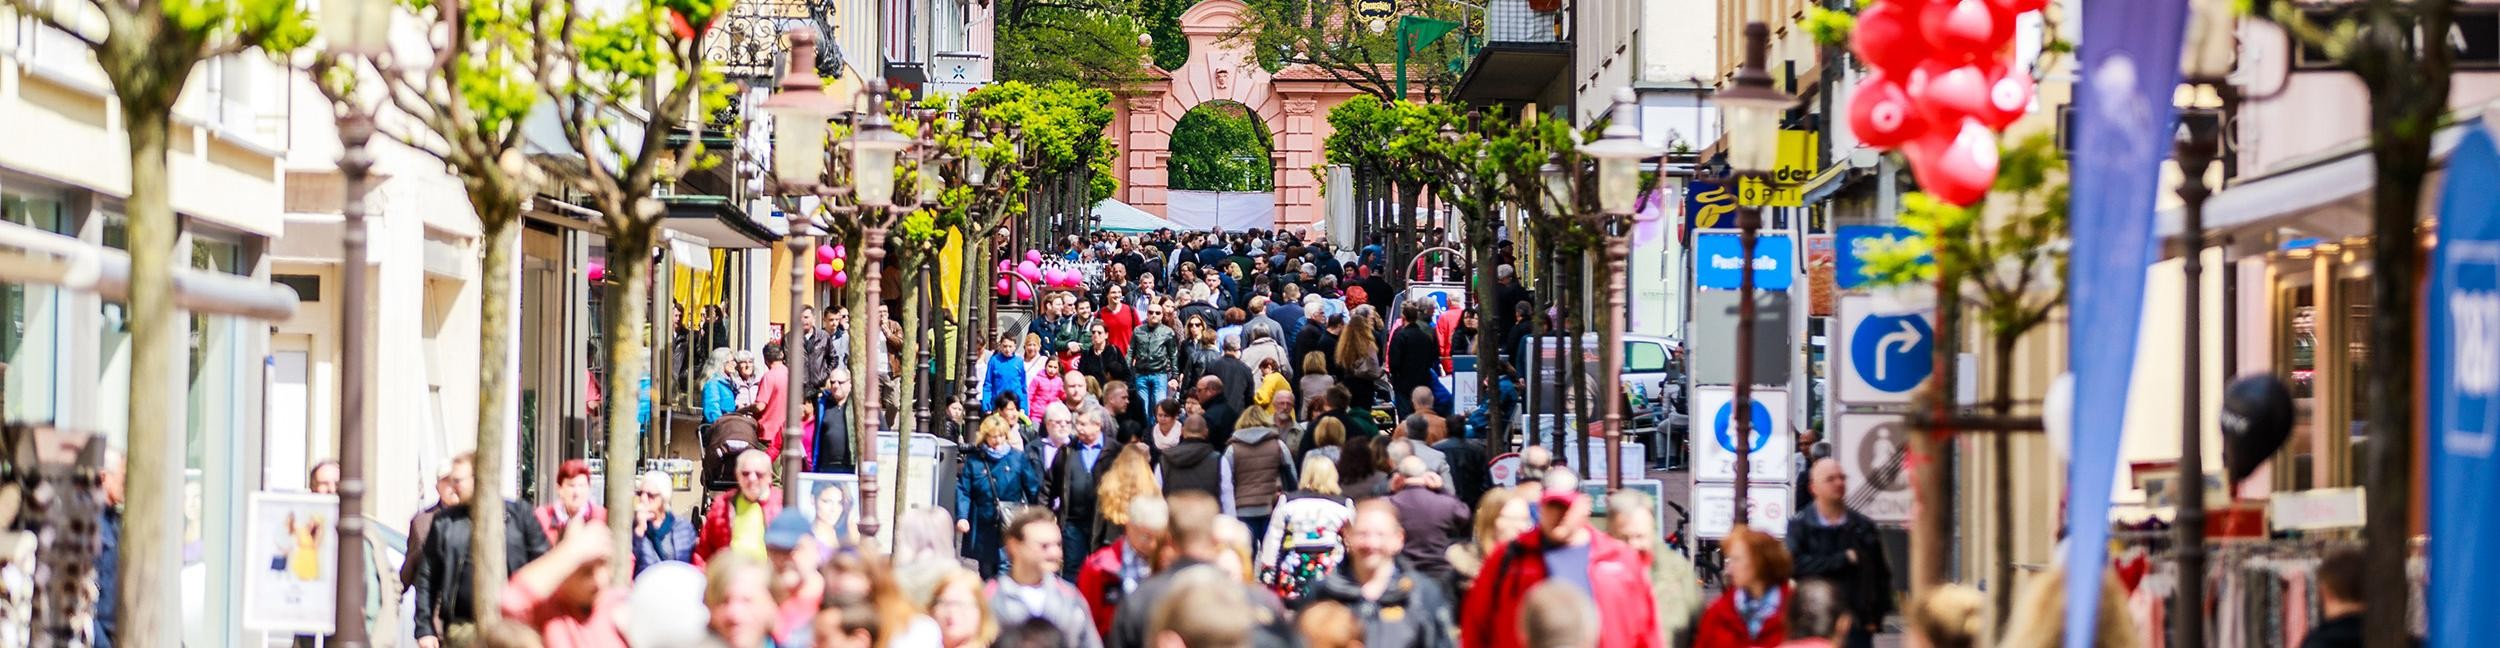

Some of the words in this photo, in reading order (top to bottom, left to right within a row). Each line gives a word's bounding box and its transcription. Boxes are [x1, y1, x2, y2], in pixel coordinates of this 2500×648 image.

[1744, 187, 1797, 201] OPTI
[1711, 253, 1777, 271] Postsaße
[1720, 460, 1764, 474] ZE
